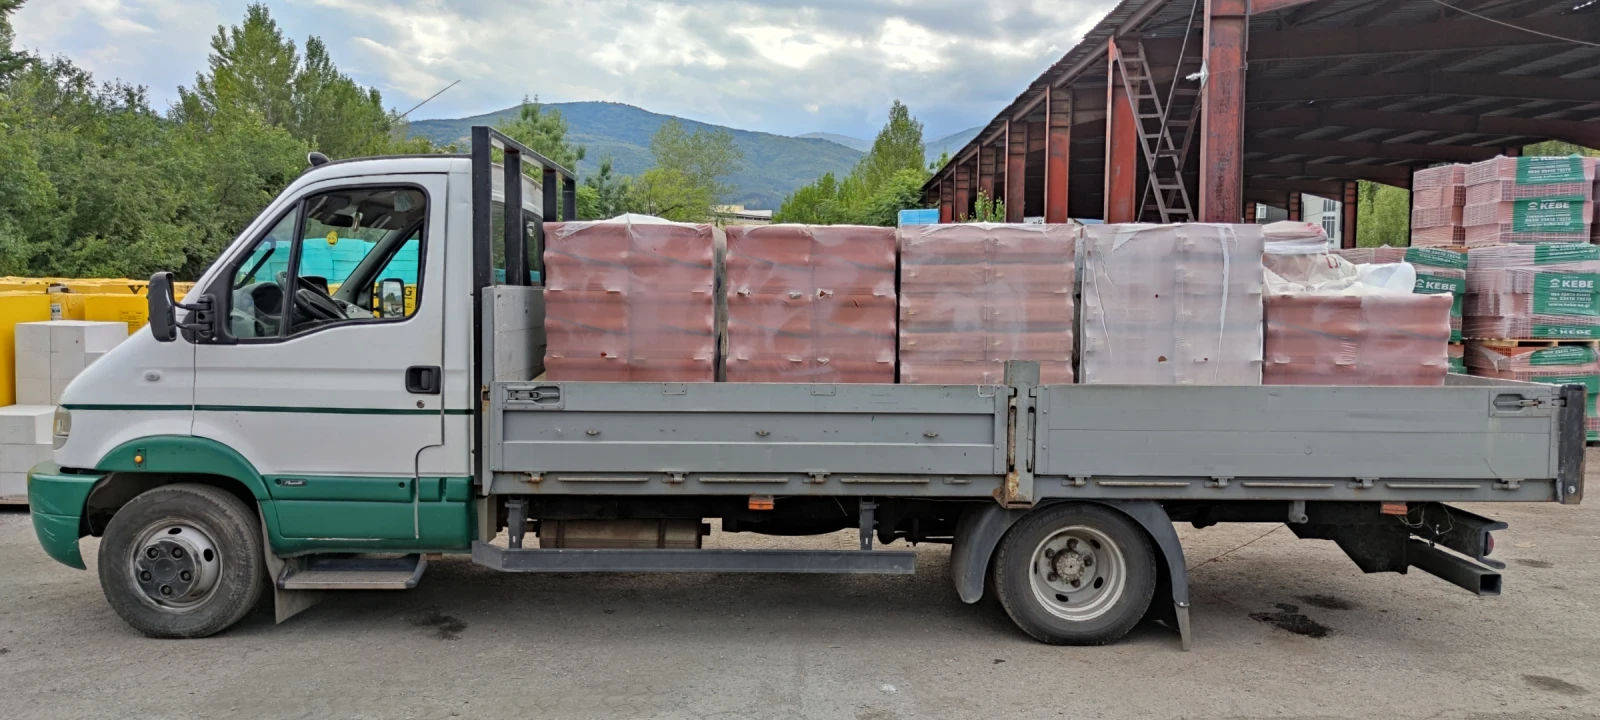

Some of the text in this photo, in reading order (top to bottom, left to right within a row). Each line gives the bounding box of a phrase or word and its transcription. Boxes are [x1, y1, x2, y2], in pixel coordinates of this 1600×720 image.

[1540, 202, 1570, 210] KEBE
[1425, 281, 1457, 292] KEBE
[1562, 280, 1594, 289] KEBE
